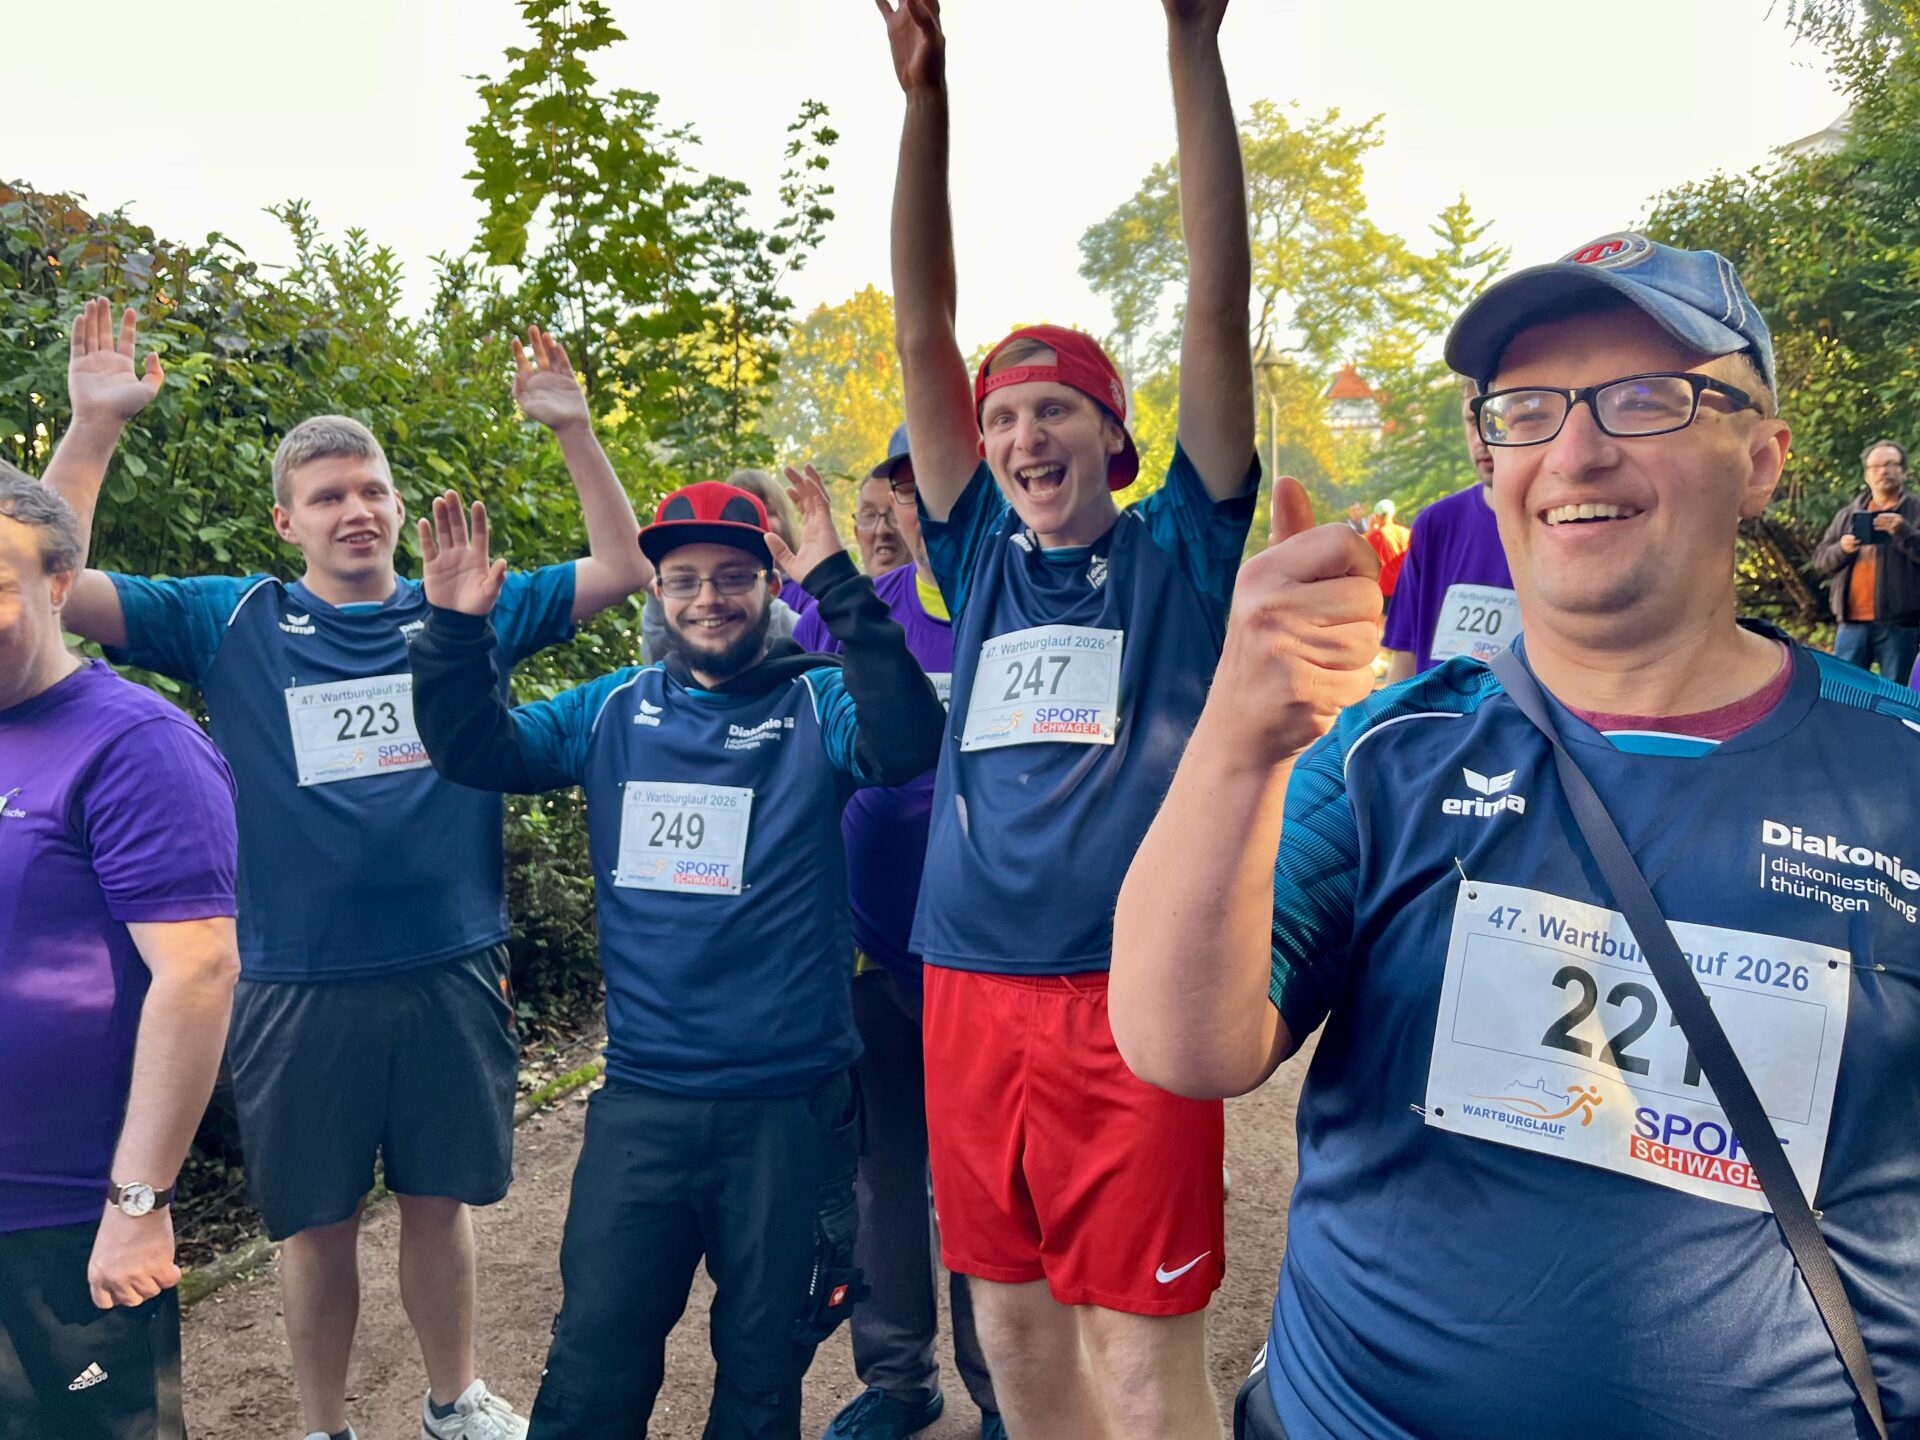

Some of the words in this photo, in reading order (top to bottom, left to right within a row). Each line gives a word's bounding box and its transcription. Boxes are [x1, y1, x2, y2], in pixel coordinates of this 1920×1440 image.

[1455, 605, 1502, 635] 220
[1000, 635, 1071, 655] Wartburglauf
[1075, 636, 1105, 650] 2026
[321, 685, 393, 703] Wartburglauf
[395, 683, 412, 693] 202
[1002, 656, 1071, 701] 247
[333, 702, 400, 741] 223
[1034, 723, 1099, 734] SCHWAGER
[1035, 707, 1100, 723] SPORT
[378, 741, 423, 758] SPOR
[646, 792, 708, 806] Wartburglauf
[710, 795, 737, 807] 2026
[1441, 793, 1526, 817] erima
[648, 811, 705, 850] 249
[675, 861, 730, 877] SPORT
[1762, 819, 1920, 890] Diakonie
[674, 874, 729, 887] SCHWAGER
[1770, 875, 1870, 913] thüringen
[1771, 856, 1918, 923] diakoniestiftung
[1487, 905, 1527, 934] 47.
[1734, 955, 1809, 992] 2026
[1462, 1103, 1567, 1135] WARTBURGLAUF
[1634, 1107, 1789, 1160] SPO
[1635, 1139, 1762, 1189] SCHWAGE
